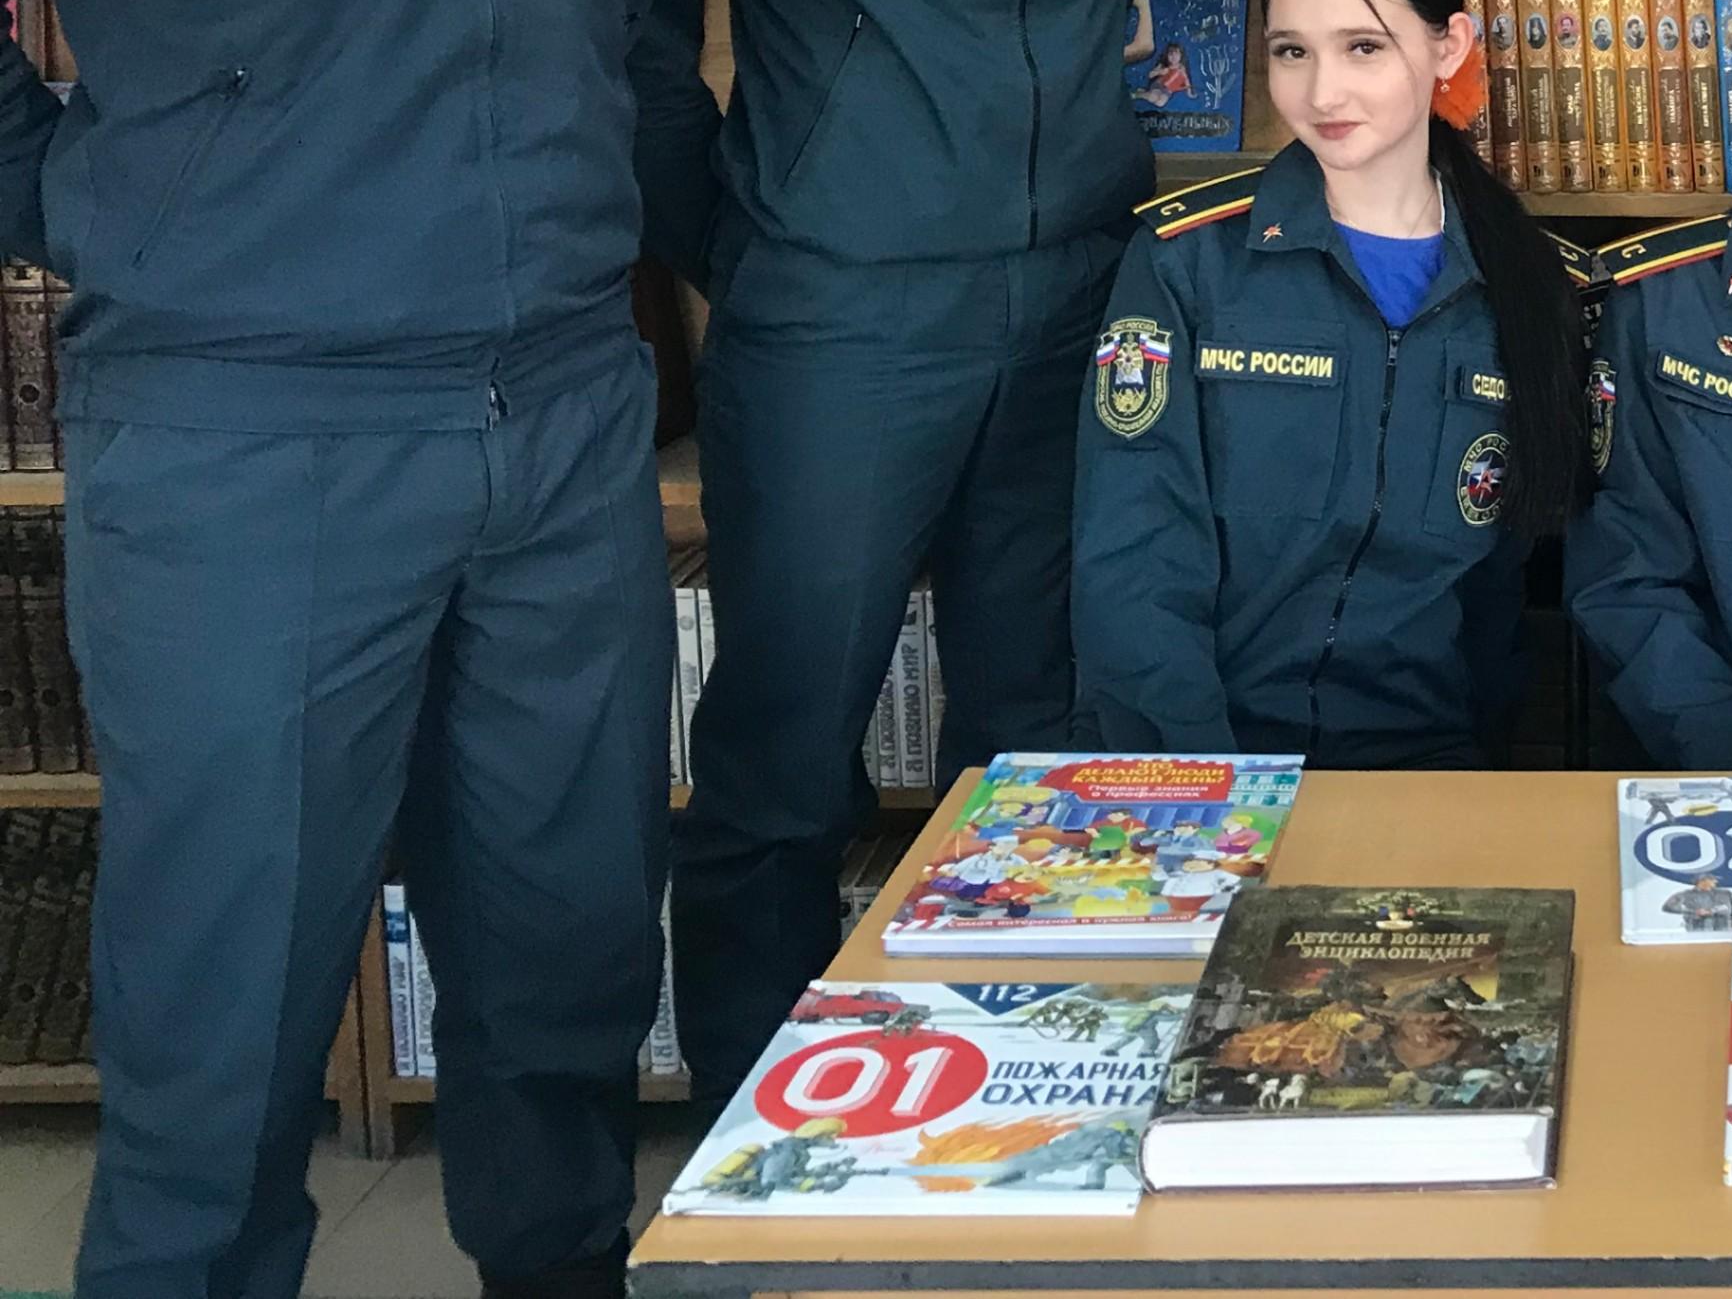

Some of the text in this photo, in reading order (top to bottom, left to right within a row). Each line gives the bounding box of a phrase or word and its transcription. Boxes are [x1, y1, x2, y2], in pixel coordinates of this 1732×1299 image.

[1201, 347, 1333, 379] МЧС РОССИИ
[1662, 355, 1701, 387] МЧС
[1472, 373, 1512, 400] СЕДО
[901, 643, 924, 773] Я ПОЗНАЮ МИР
[1077, 769, 1225, 777] ДЕЛАЮТ ЛЮДИ
[1136, 761, 1173, 769] ЧТО
[1071, 775, 1226, 785] КАЖДЫЙ ДЕНЬ?
[1105, 791, 1200, 799] профессиях
[948, 919, 994, 928] Самая
[1285, 931, 1491, 947] ДЕТСКАЯ ВОЕННАЯ
[978, 985, 1037, 1001] 112
[992, 1060, 1168, 1080] ПОЖАРНАЯ
[782, 1045, 955, 1117] 01
[981, 1083, 1158, 1106] ОХРАНА
